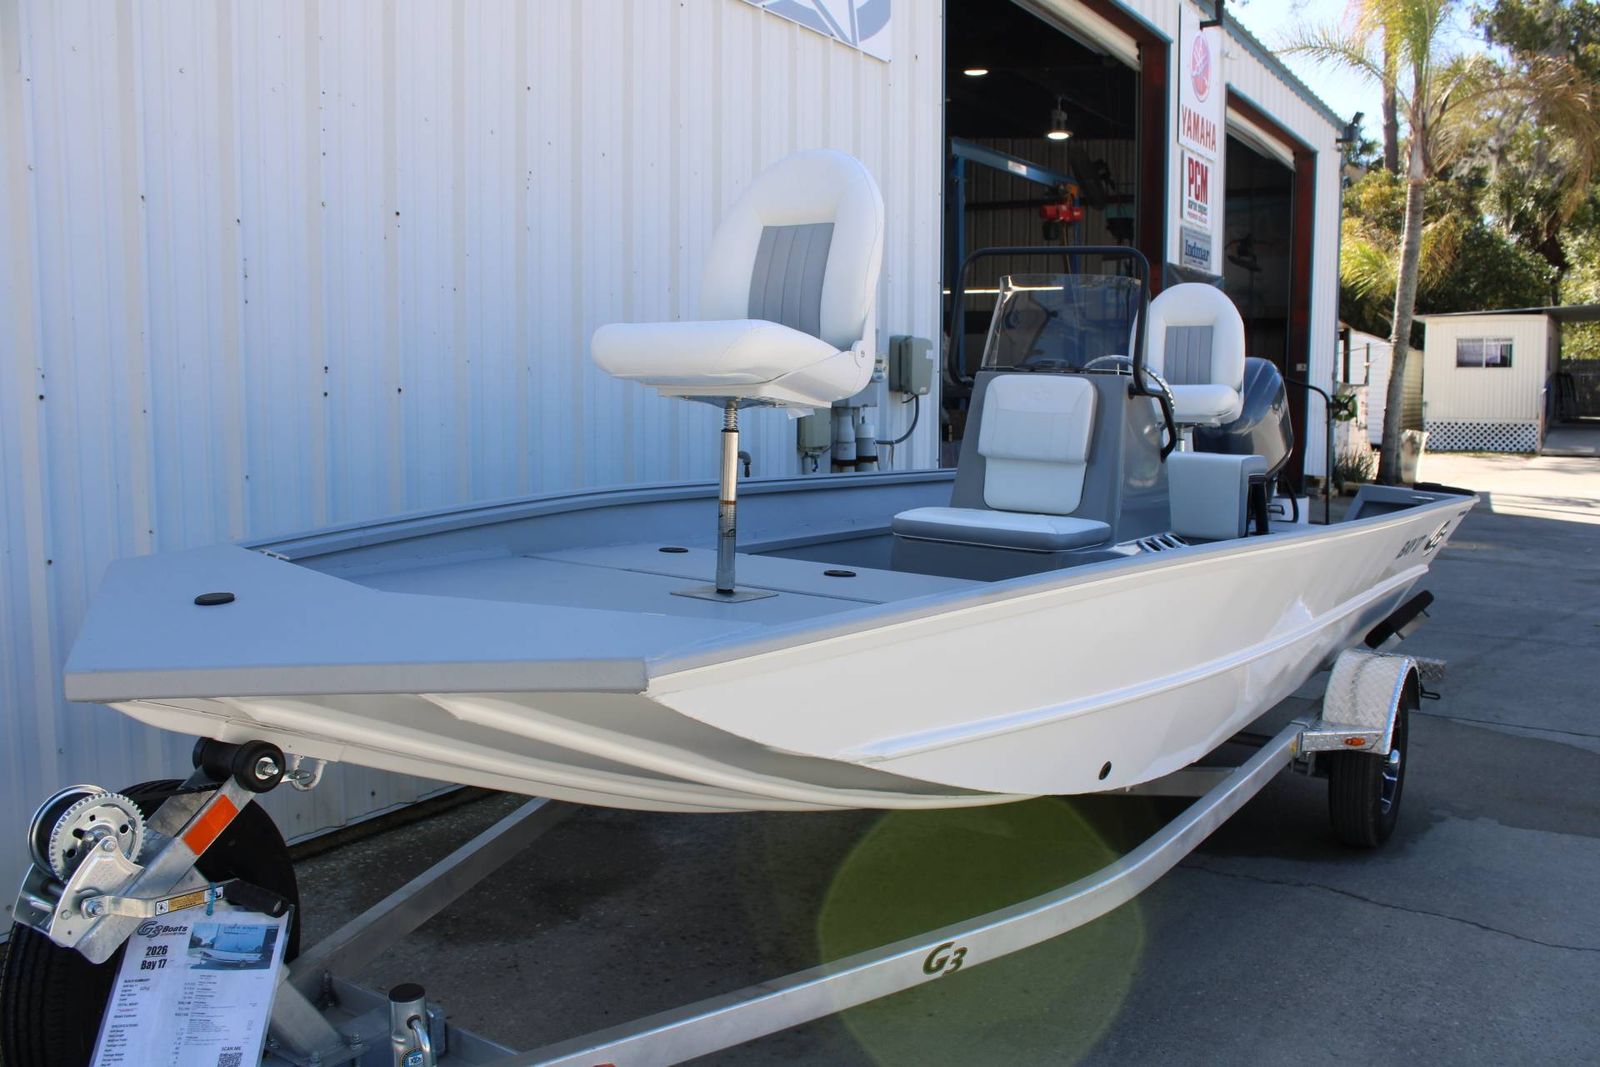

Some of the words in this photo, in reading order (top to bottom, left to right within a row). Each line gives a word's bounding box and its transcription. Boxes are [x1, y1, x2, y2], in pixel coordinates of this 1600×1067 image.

[1181, 104, 1217, 152] YAMAHA
[1188, 157, 1208, 205] PCM
[1184, 239, 1210, 262] Indmar
[137, 920, 163, 938] G3
[161, 925, 188, 933] Boats
[145, 945, 168, 956] 2026
[922, 941, 968, 976] G3
[140, 959, 157, 970] Bay
[158, 958, 168, 969] 17
